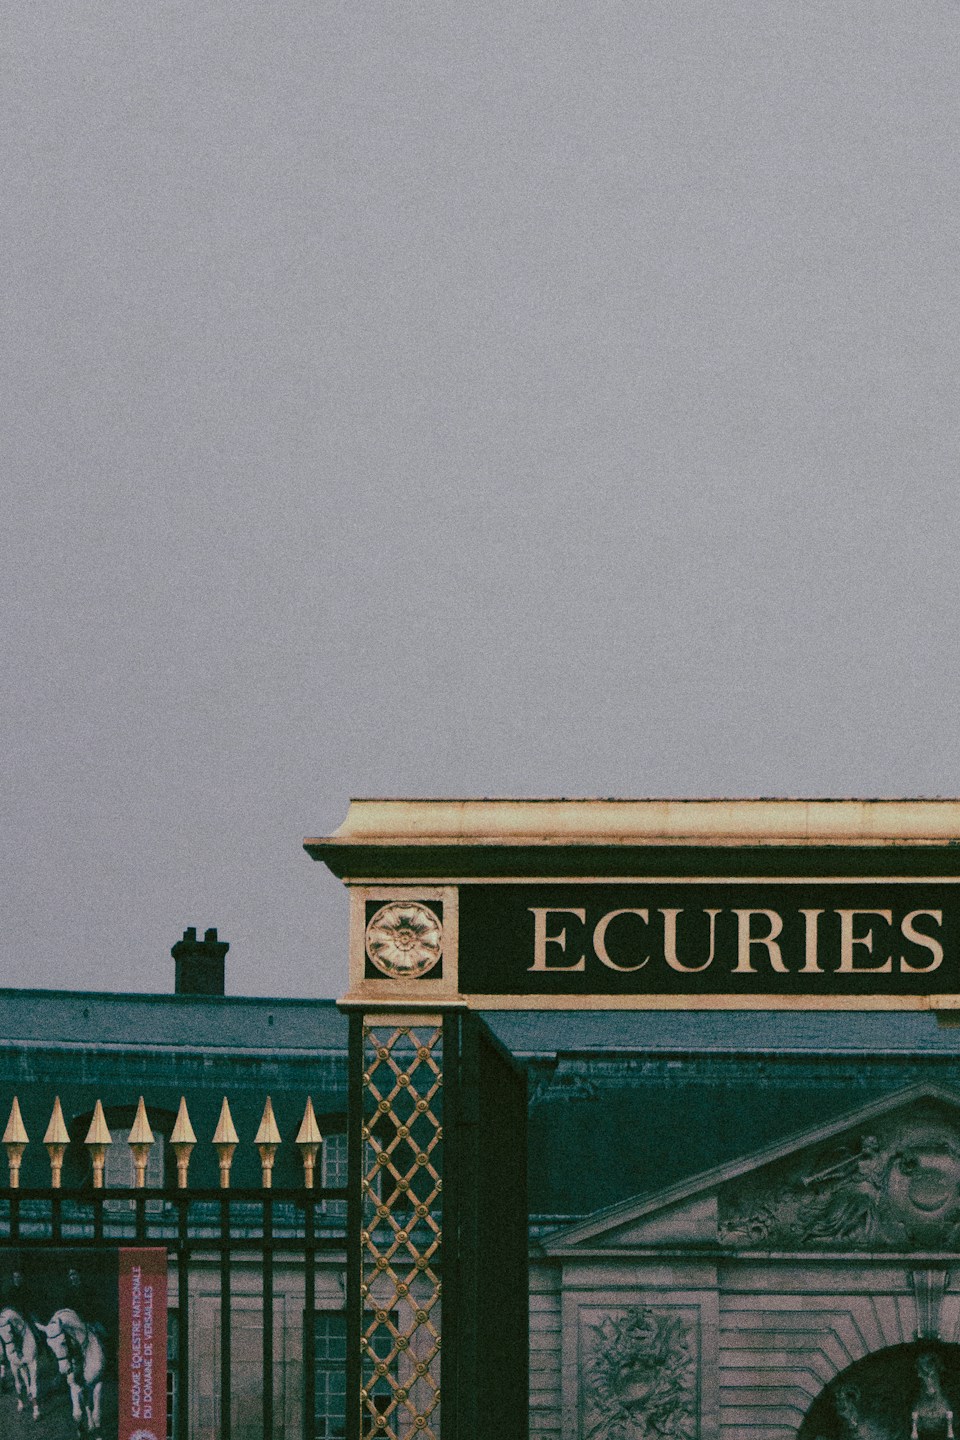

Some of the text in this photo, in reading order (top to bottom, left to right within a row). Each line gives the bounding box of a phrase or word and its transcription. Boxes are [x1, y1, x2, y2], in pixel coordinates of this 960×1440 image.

[527, 907, 944, 973] ECURIES
[131, 1265, 141, 1318] NATIONALE
[143, 1286, 153, 1419] DU DOMAINE DE VERSAILLES
